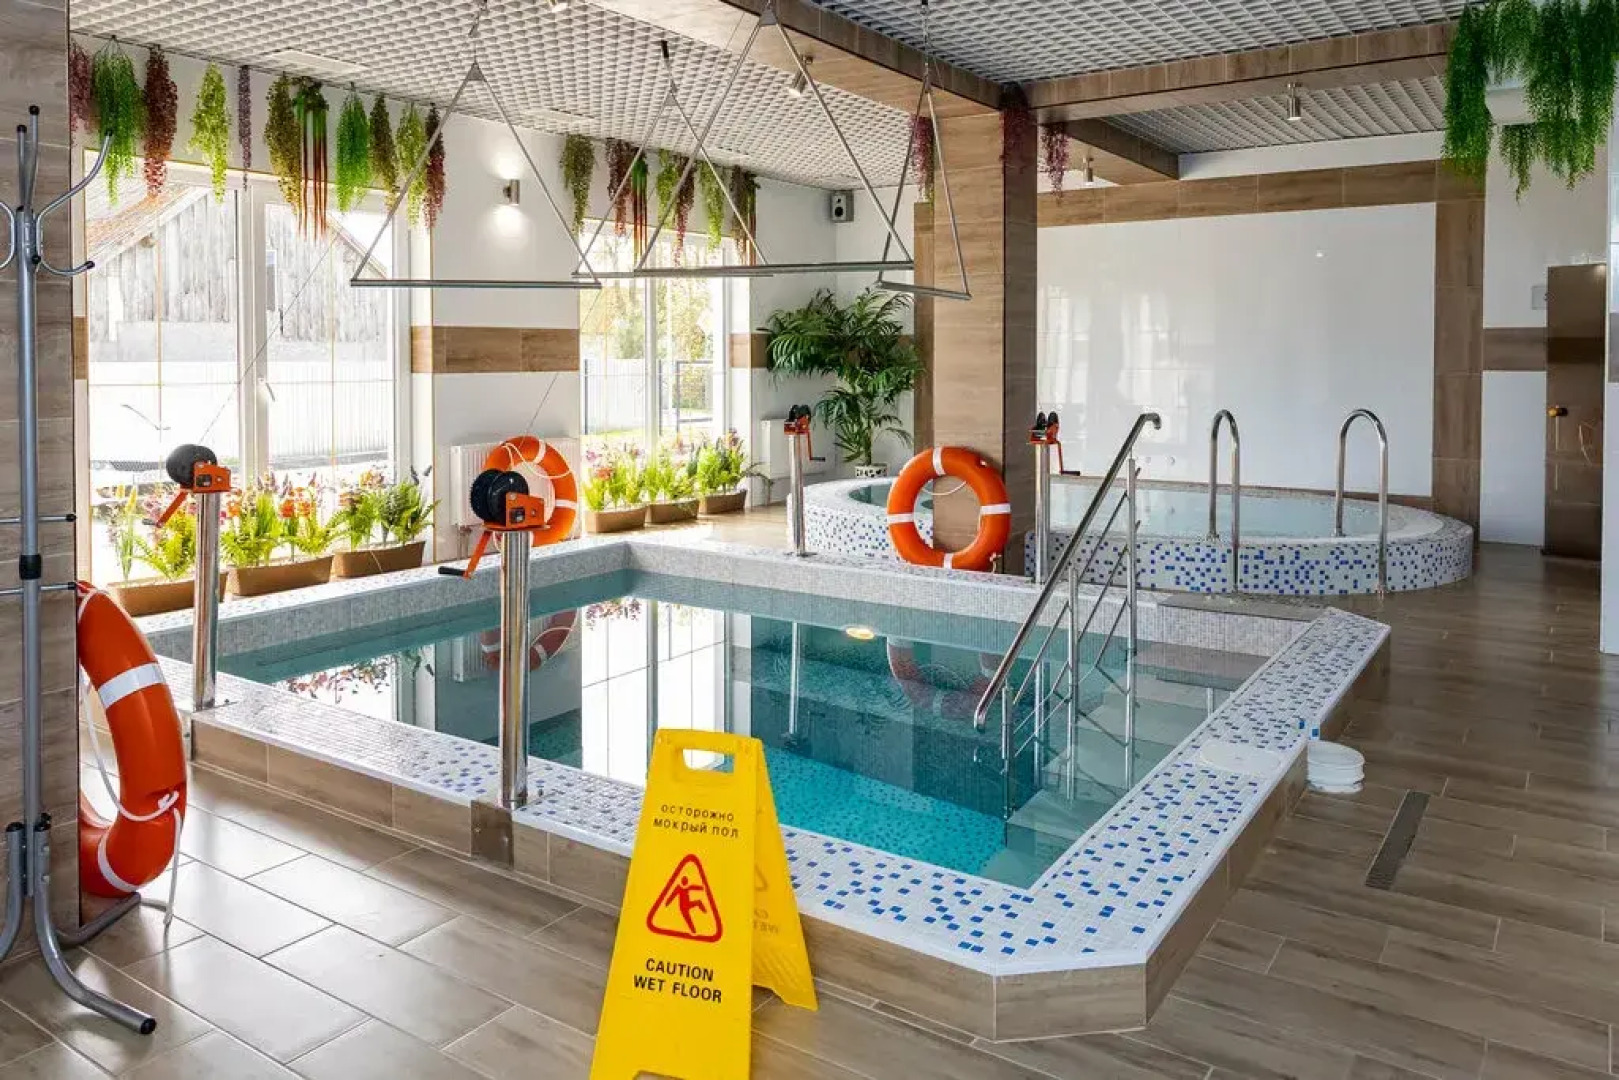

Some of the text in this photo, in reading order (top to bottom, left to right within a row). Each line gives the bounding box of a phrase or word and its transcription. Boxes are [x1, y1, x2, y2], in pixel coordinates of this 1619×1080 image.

[645, 957, 714, 982] CAUTION
[633, 975, 722, 1003] WET FLOOR
